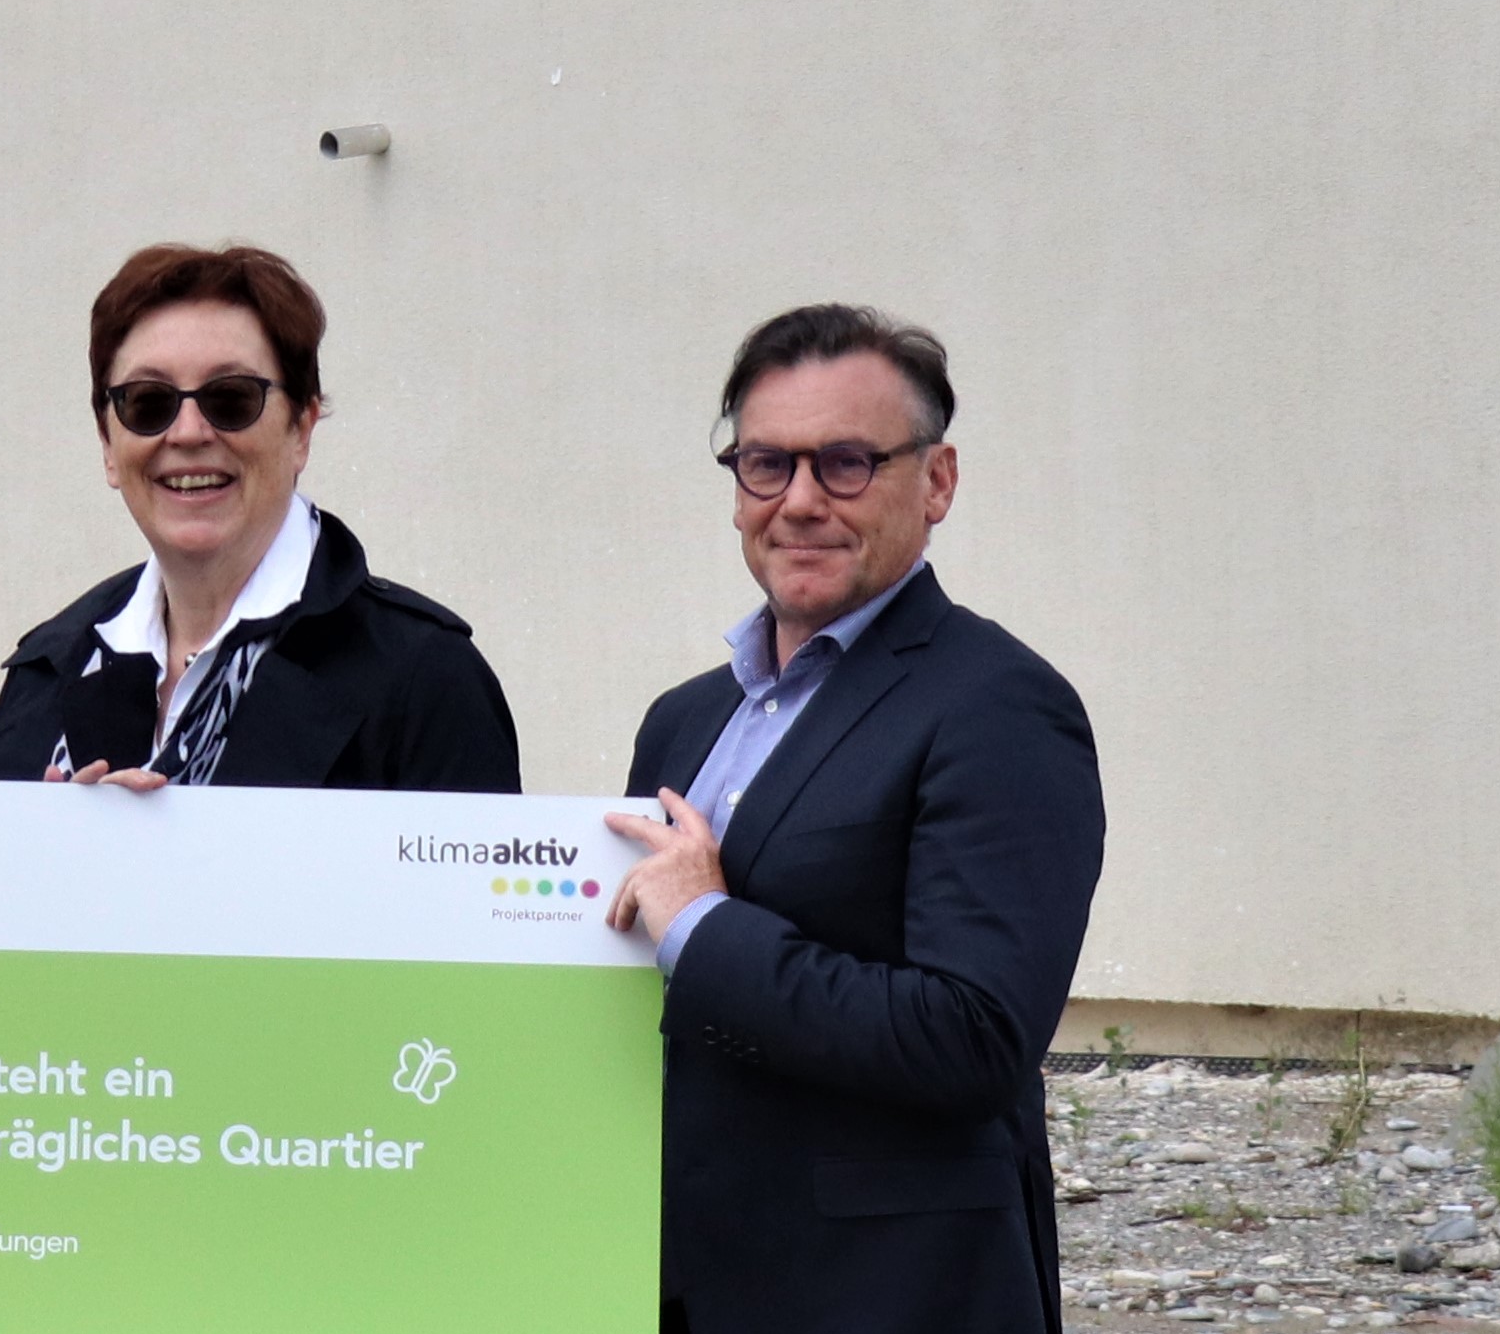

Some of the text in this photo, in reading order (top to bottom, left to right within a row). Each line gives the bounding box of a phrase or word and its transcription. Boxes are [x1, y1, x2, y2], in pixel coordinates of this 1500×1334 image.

[397, 834, 579, 867] klimaaktiv
[491, 908, 584, 923] Projektpartner
[103, 1056, 174, 1098] ein
[218, 1123, 425, 1171] Quartier
